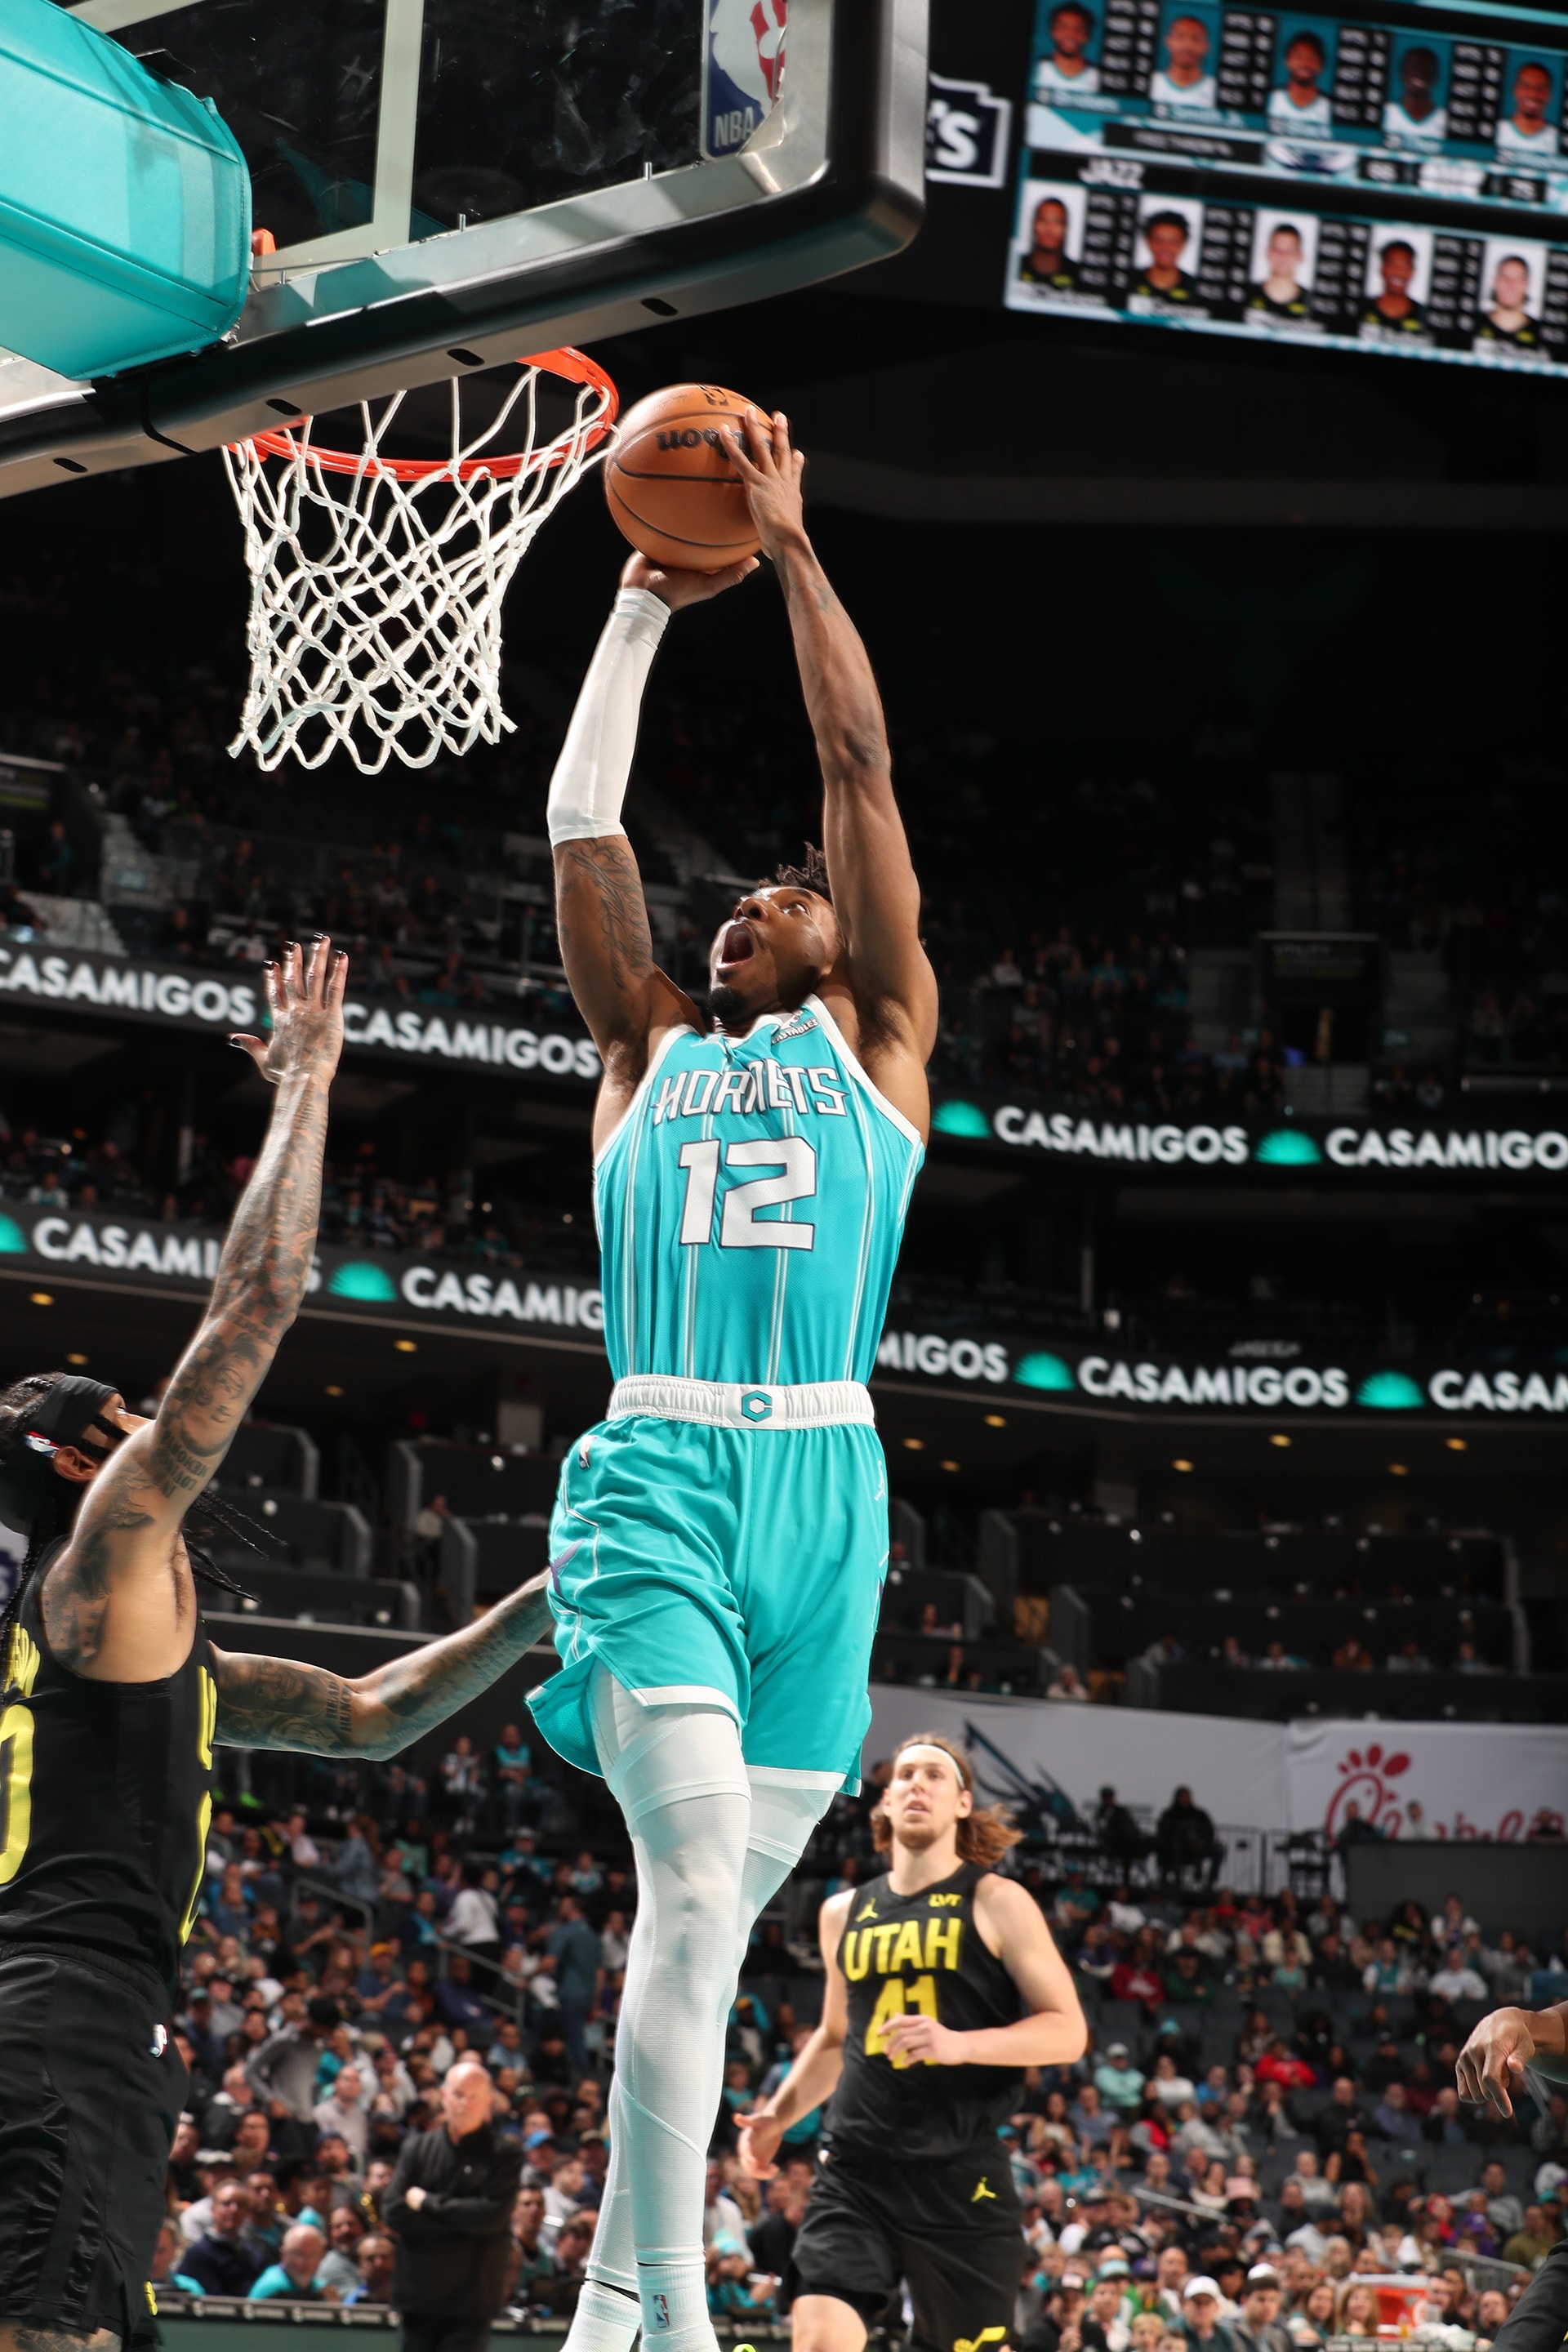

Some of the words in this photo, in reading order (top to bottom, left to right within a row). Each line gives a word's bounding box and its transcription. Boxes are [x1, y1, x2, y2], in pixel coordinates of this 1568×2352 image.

[715, 106, 755, 149] NBA
[1078, 159, 1145, 189] JAZZ
[345, 1003, 602, 1079] CASAMIGOS
[653, 1058, 850, 1127] HORNETS
[994, 1106, 1249, 1165] CASAMIGOS
[679, 1136, 817, 1252] 12
[33, 1216, 322, 1294] CASAMIS
[1078, 1356, 1349, 1407] CASAMIGOS
[844, 1917, 961, 1982] UTAH
[865, 1974, 939, 2070] 41
